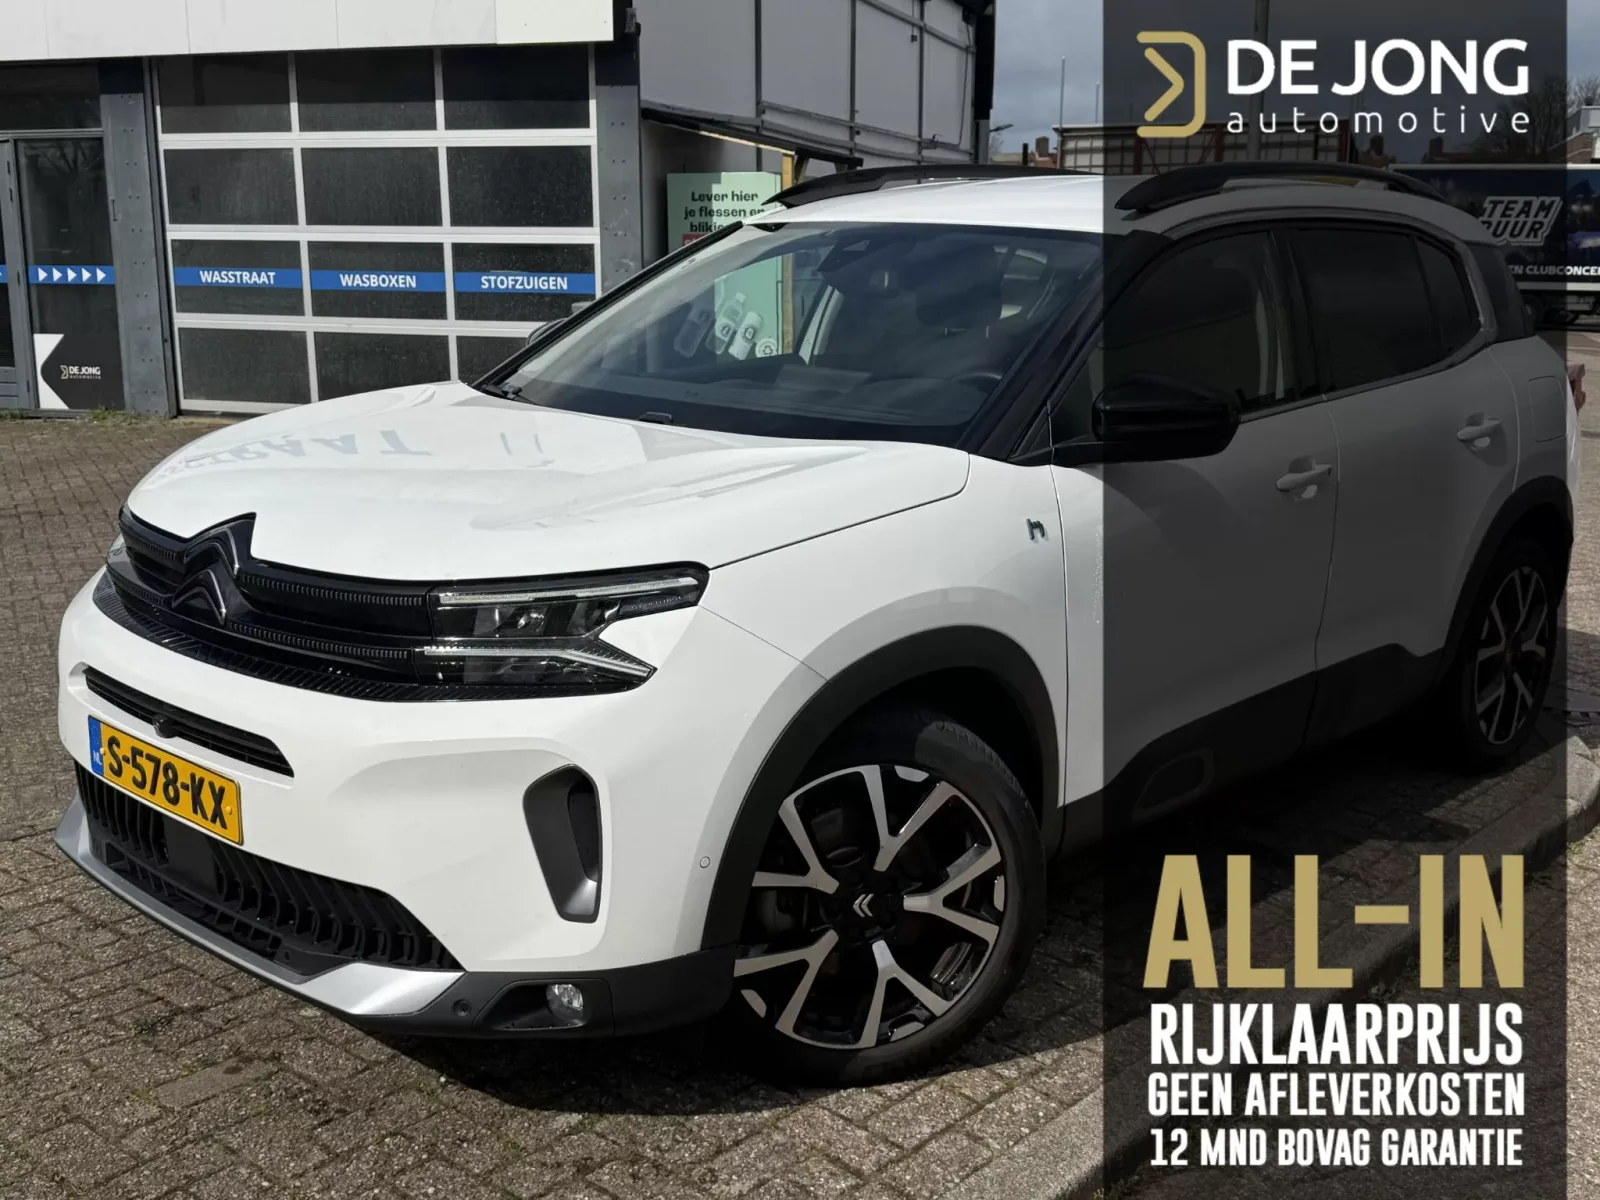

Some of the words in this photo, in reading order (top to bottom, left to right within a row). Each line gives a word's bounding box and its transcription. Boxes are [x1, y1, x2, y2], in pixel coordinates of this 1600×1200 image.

[691, 191, 728, 202] Lever
[731, 191, 758, 202] hier
[684, 206, 696, 220] je
[699, 206, 746, 217] flessen
[1487, 200, 1557, 218] TEAM
[199, 270, 276, 286] WASSTRAAT
[1525, 265, 1600, 275] CLUBCONCE
[339, 273, 417, 289] WASBOXEN
[480, 275, 568, 291] STOFZUIGEN
[69, 366, 79, 374] DE
[80, 366, 101, 374] JONG
[107, 735, 228, 830] S-578-KX
